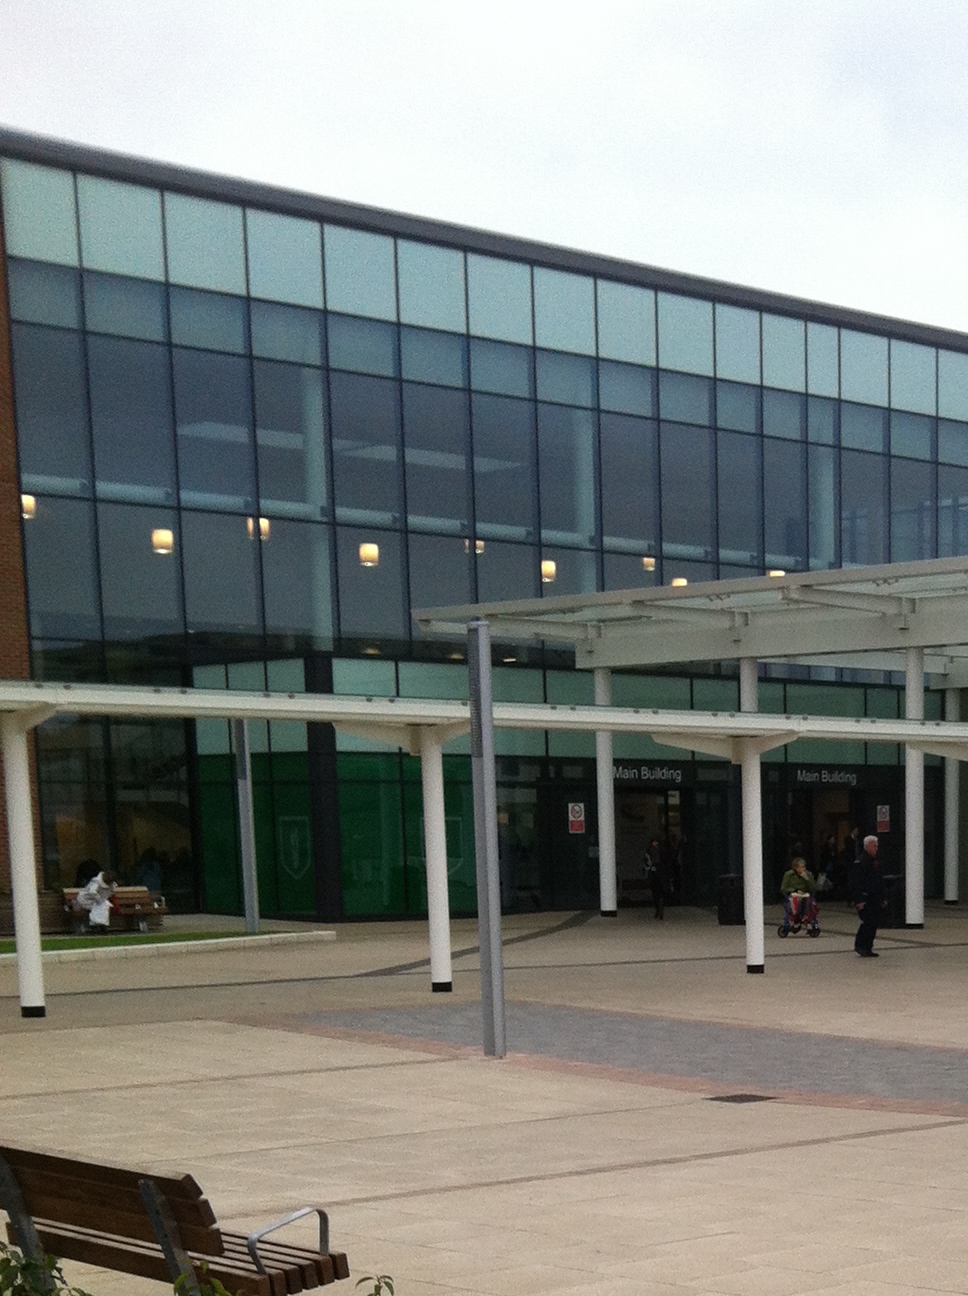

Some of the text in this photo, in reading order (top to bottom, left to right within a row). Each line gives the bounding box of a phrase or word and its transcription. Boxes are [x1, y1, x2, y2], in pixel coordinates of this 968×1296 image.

[613, 766, 682, 783] Main Building
[797, 769, 857, 786] Main Building
